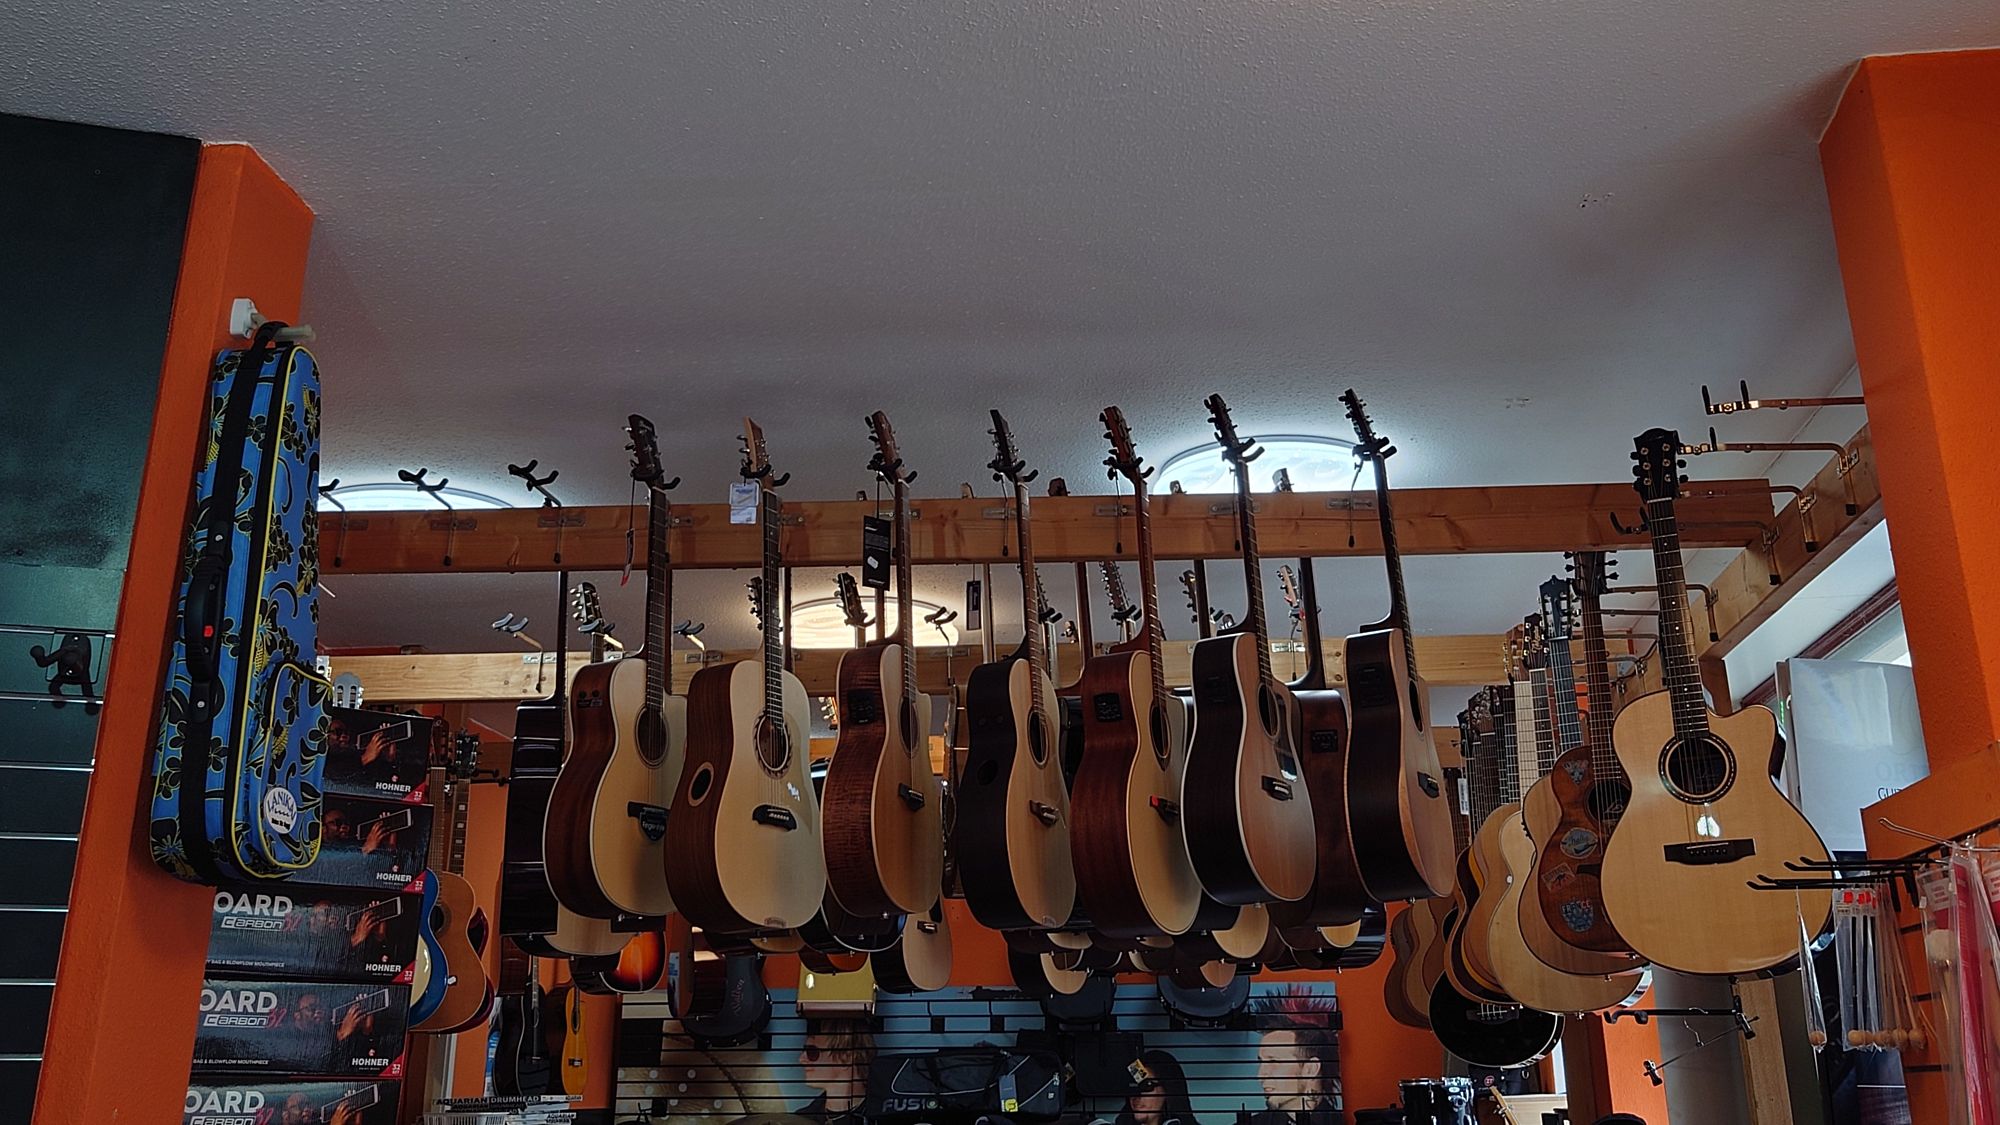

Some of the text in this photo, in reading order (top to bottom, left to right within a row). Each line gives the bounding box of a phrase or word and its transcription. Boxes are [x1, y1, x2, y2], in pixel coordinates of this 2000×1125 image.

[375, 782, 411, 792] HOHNER
[376, 872, 412, 882] HOHNER
[365, 963, 402, 972] HOHNER
[351, 1058, 389, 1066] HOHNER
[490, 1096, 540, 1104] DRUMHEAD
